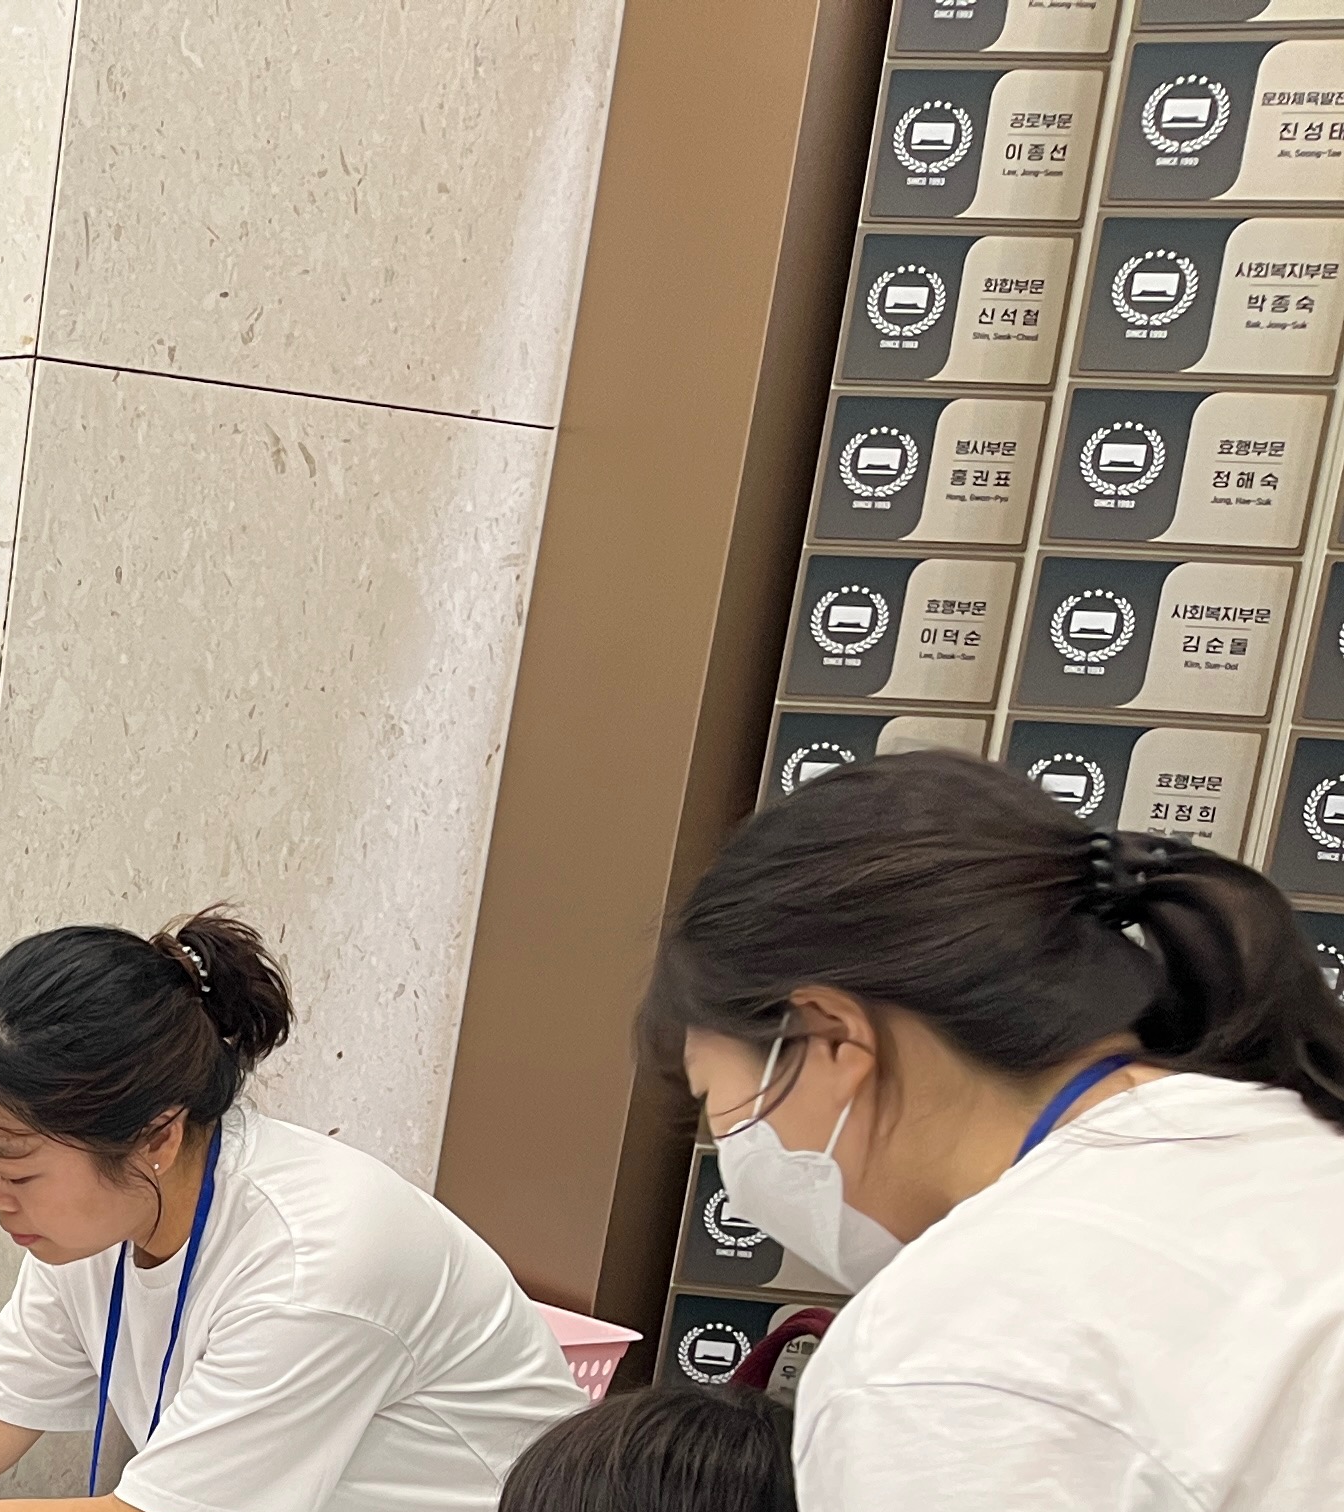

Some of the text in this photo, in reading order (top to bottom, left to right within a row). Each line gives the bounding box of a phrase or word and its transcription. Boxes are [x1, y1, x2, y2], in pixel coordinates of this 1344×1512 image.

[1009, 112, 1073, 130] 공로부문
[1235, 261, 1339, 280] 사회복지부문
[982, 277, 1045, 295] 화합부문
[955, 440, 1017, 457] 봉사부문
[1217, 439, 1286, 457] 효행부문
[925, 598, 987, 616] 효행부문
[1170, 604, 1271, 624] 사회복지부문
[1155, 773, 1223, 792] 효행부문
